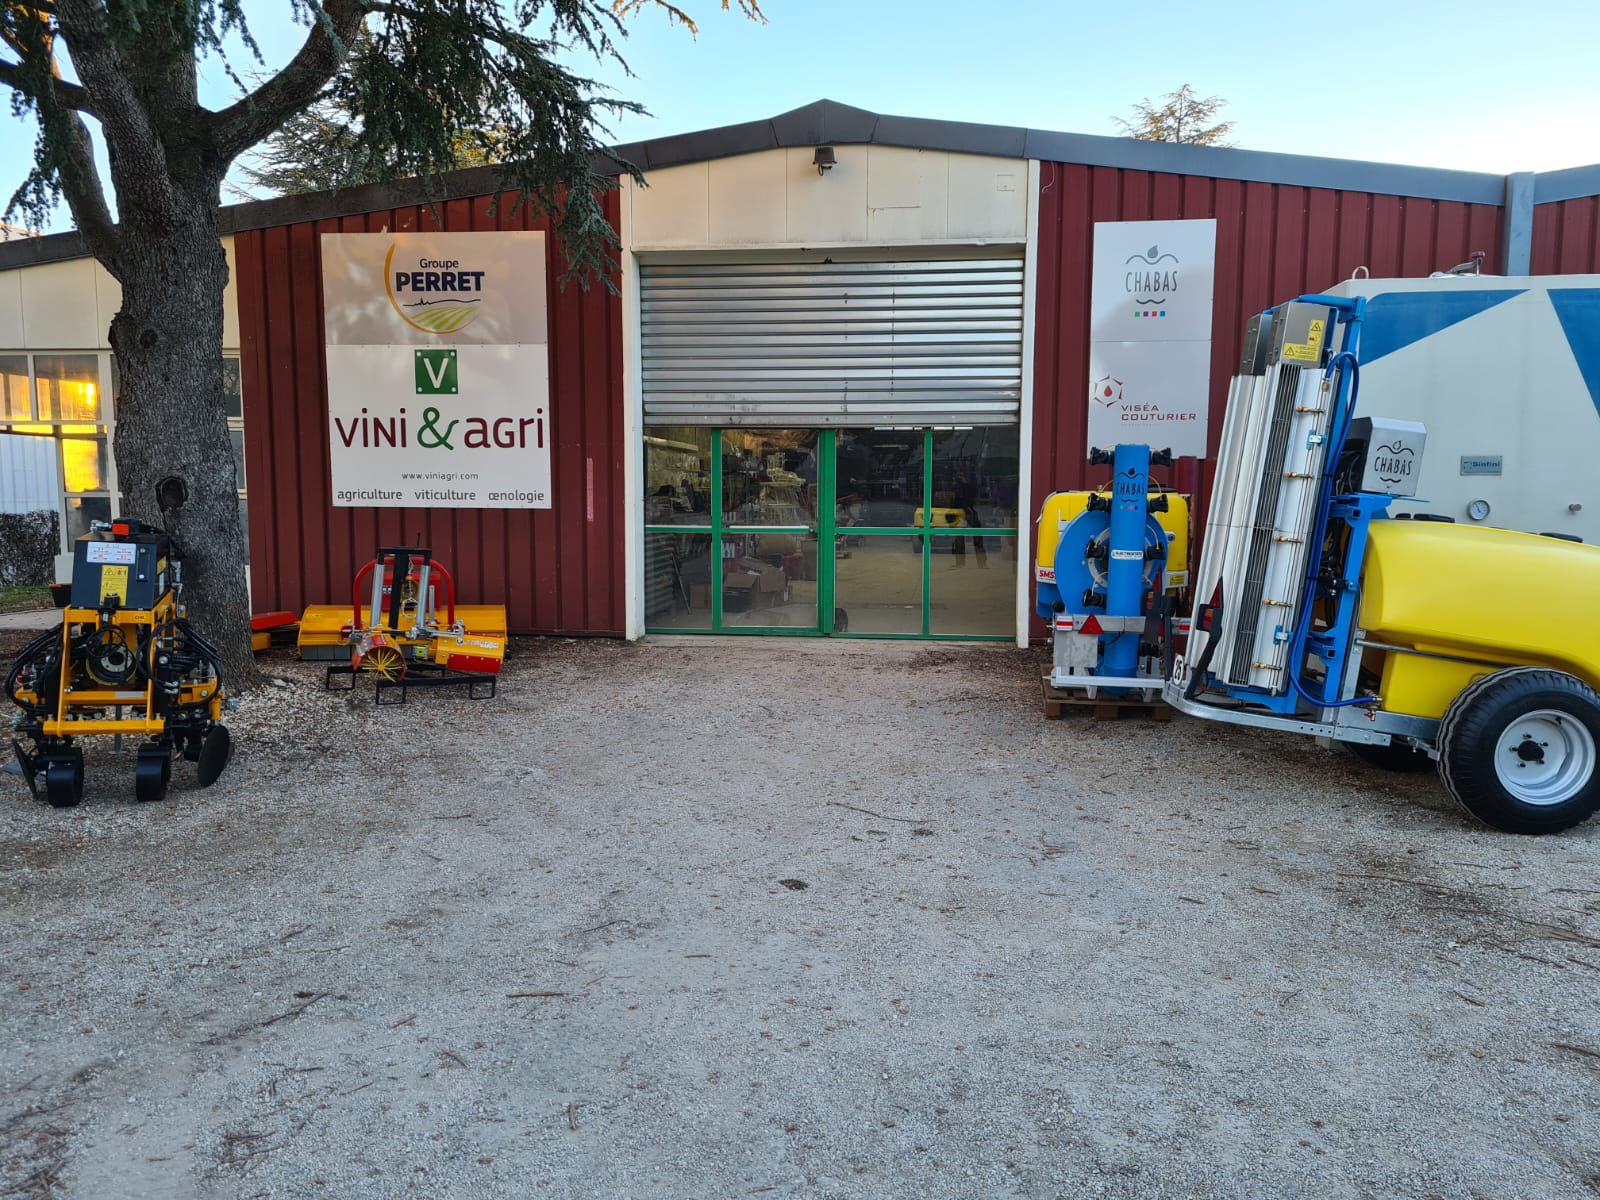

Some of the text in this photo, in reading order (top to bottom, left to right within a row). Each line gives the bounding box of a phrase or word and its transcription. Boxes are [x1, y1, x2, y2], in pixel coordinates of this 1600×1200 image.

[419, 258, 459, 270] Groupe
[395, 271, 485, 292] PERRET
[1125, 271, 1178, 292] CHABAS
[423, 357, 449, 389] V
[1121, 402, 1159, 411] VISÉA
[1121, 413, 1197, 421] COUTURIER
[416, 406, 460, 451] &
[1374, 456, 1412, 476] CHABAS
[401, 472, 479, 482] www.viniagri.com
[337, 488, 545, 503] agriculture viticulture œnologie
[1116, 482, 1145, 496] CHABAS
